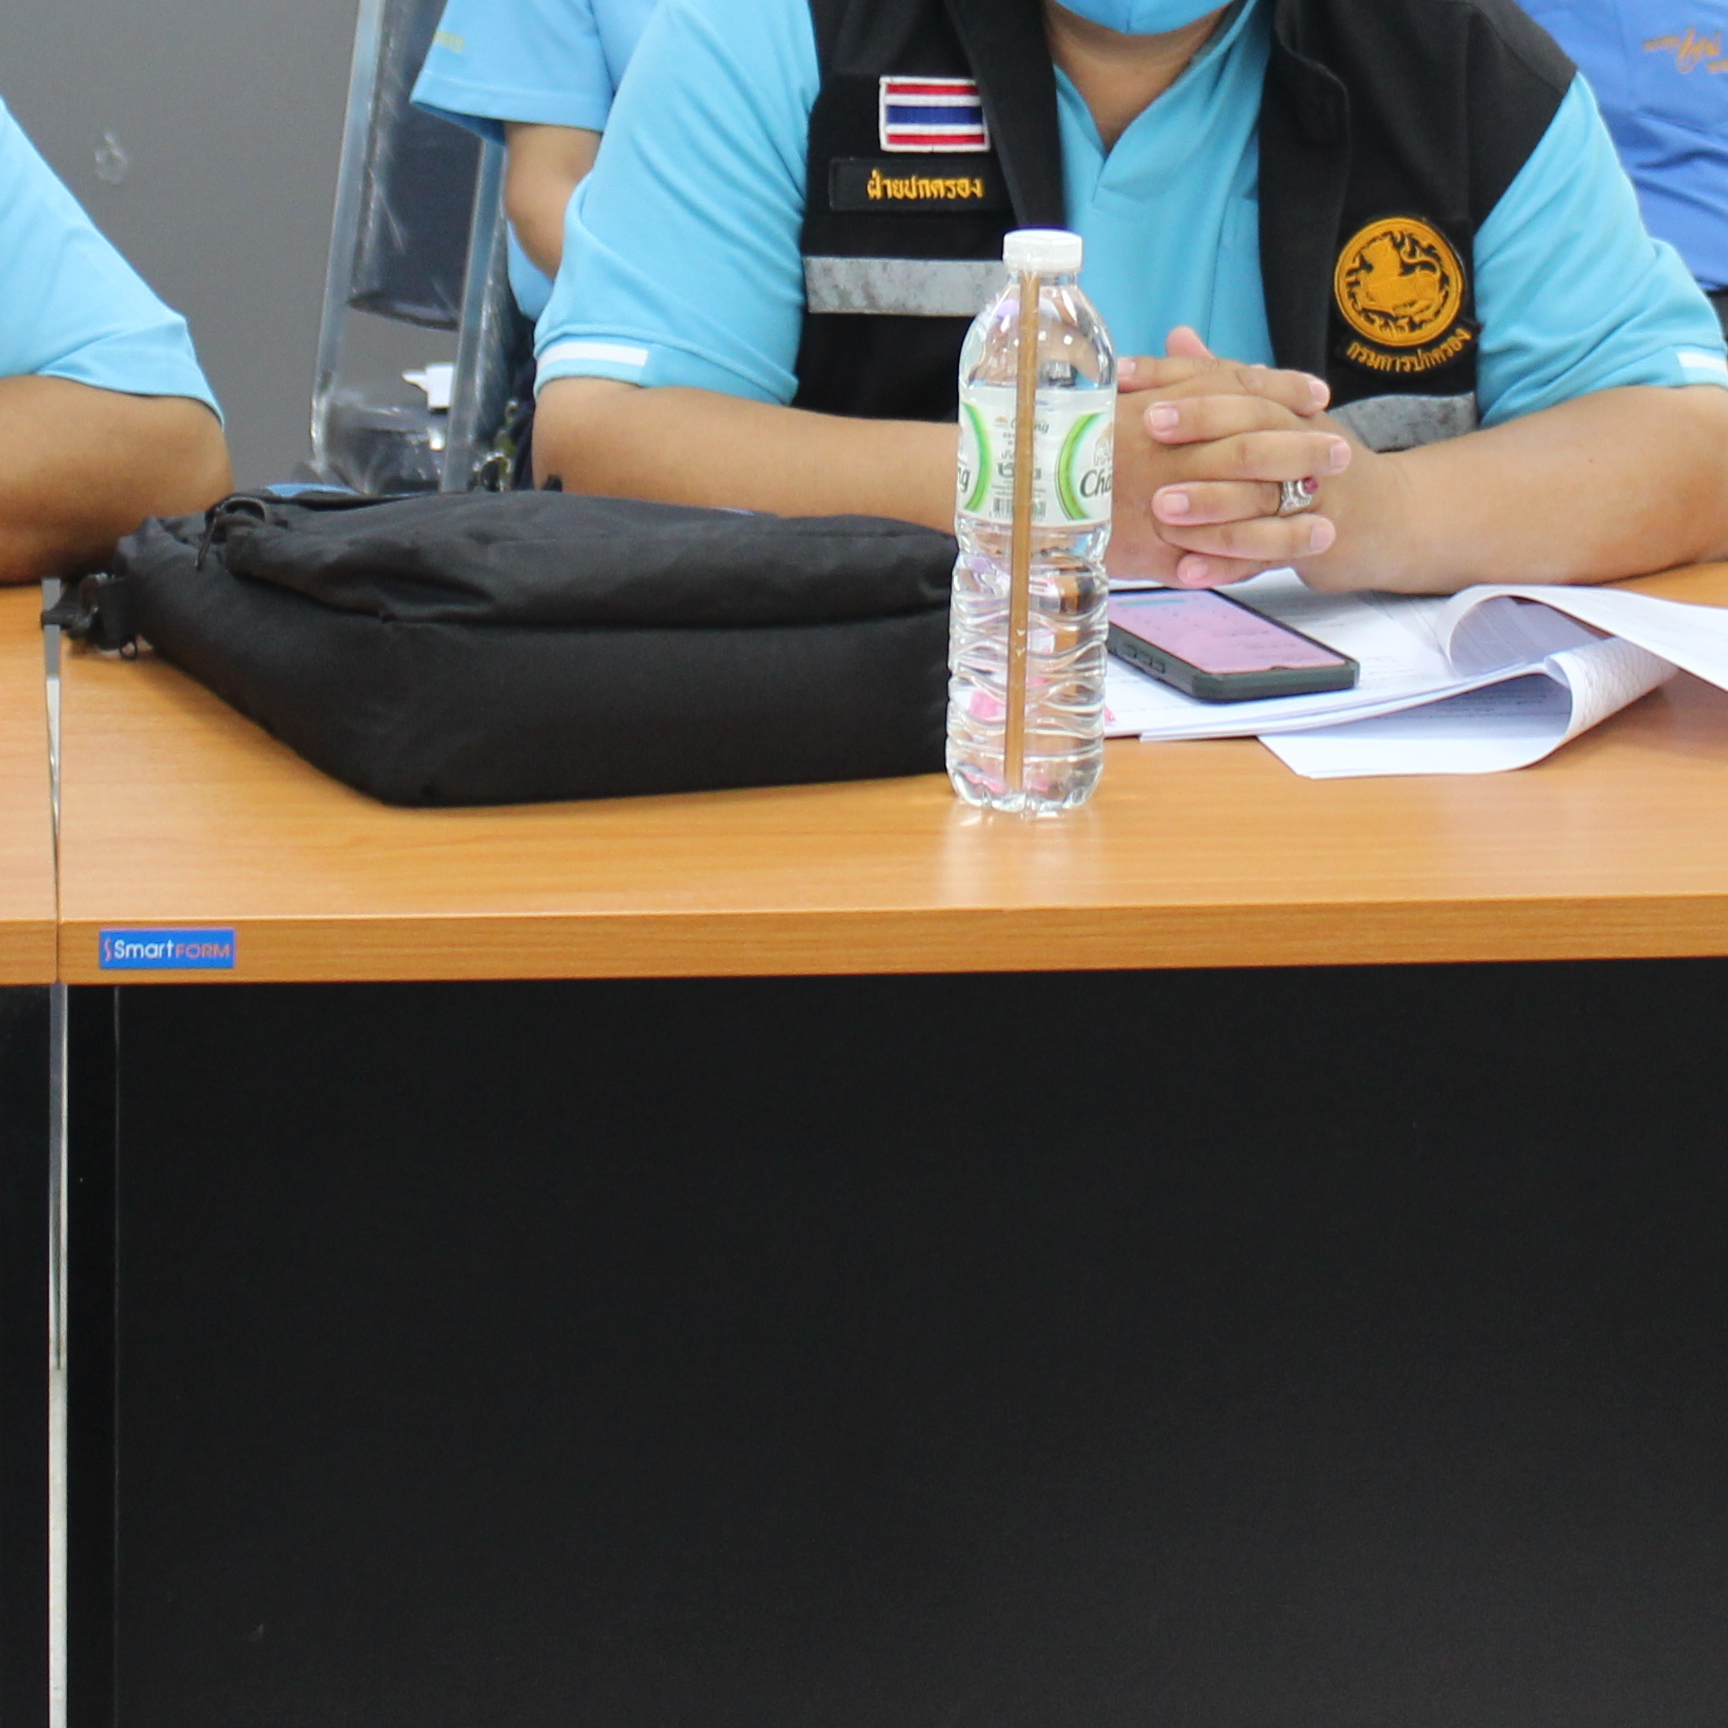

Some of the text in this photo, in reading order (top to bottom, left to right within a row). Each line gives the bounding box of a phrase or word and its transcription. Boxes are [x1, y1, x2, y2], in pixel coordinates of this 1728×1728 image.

[867, 169, 983, 199] ฝ่ายปกครอง
[1347, 328, 1471, 372] กรมการปกครอง
[1079, 468, 1113, 498] Cha
